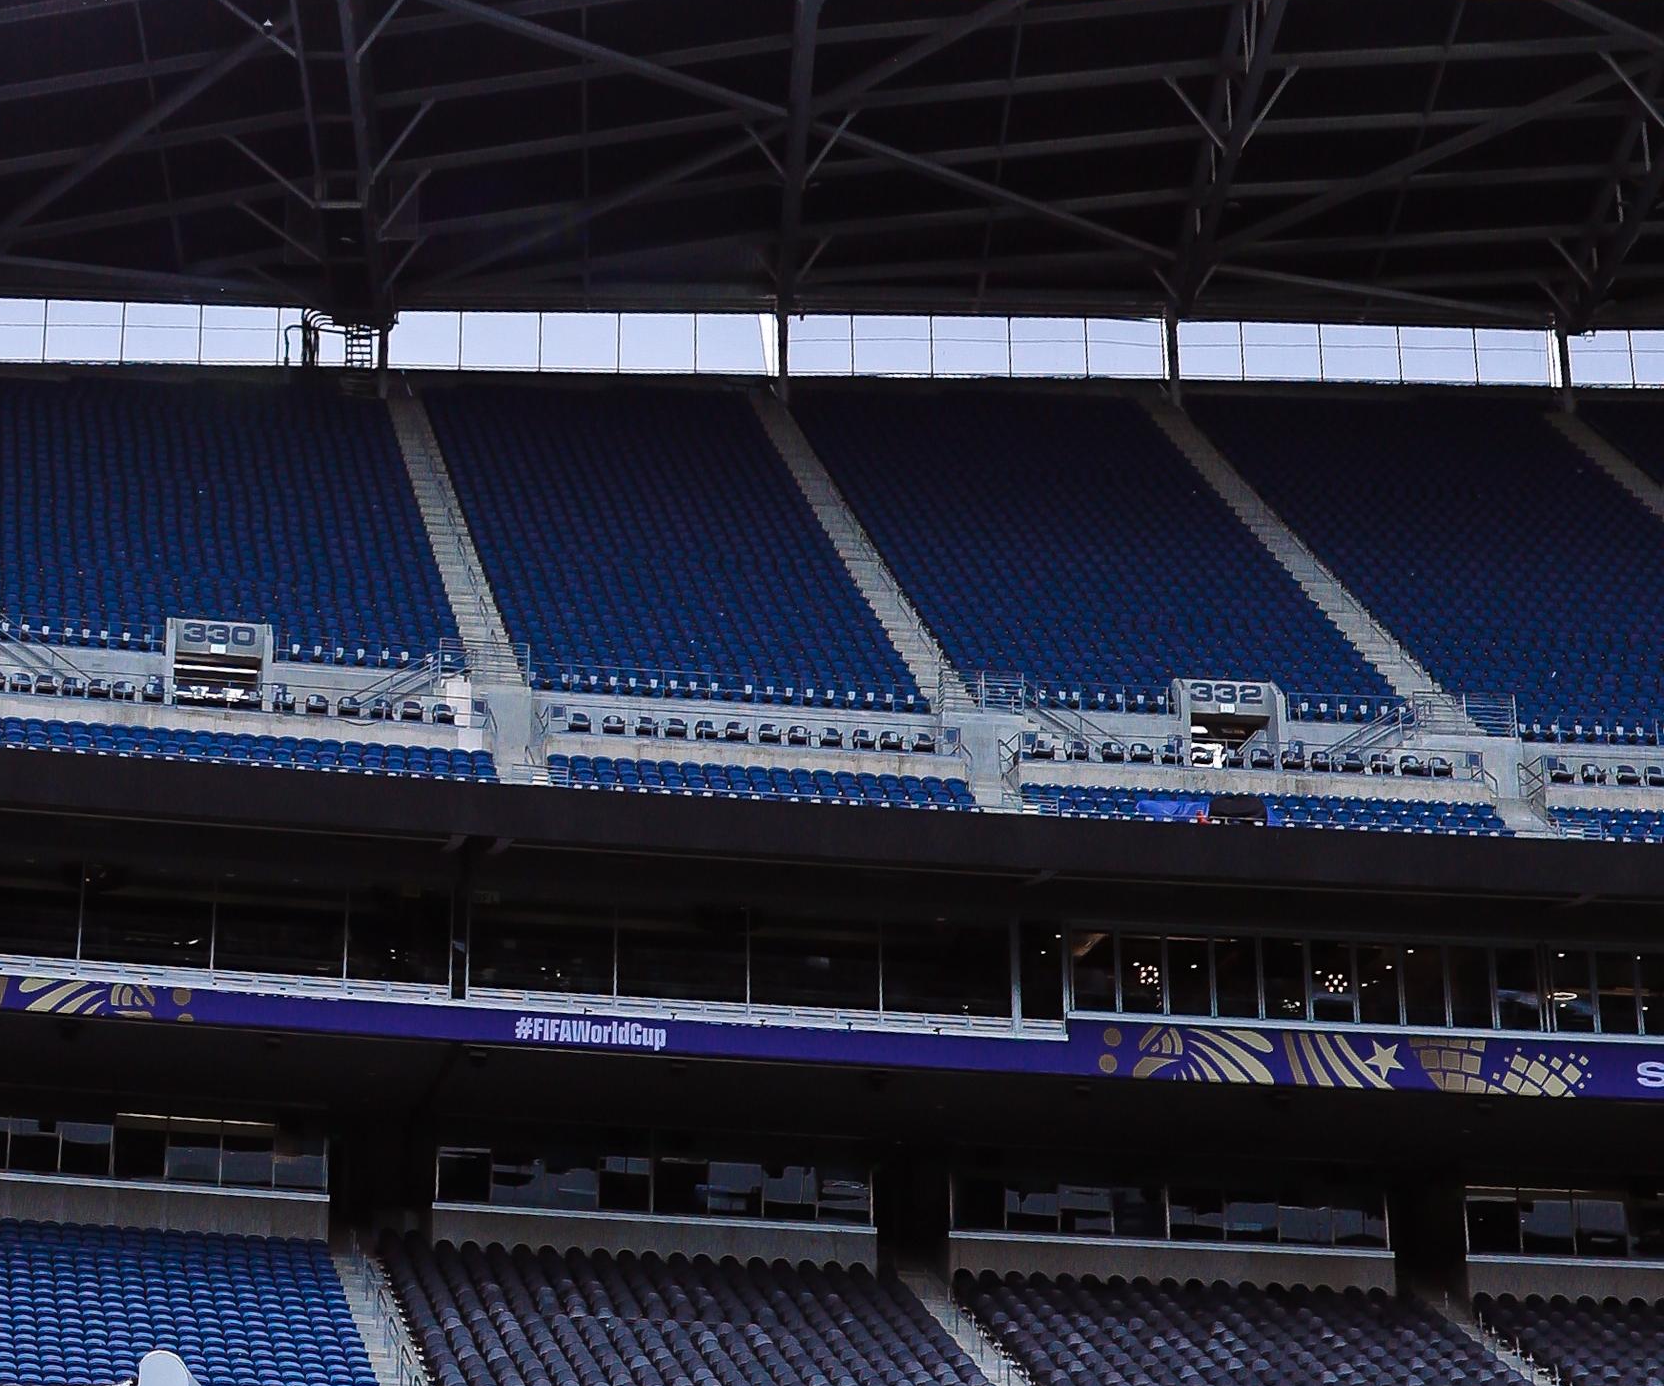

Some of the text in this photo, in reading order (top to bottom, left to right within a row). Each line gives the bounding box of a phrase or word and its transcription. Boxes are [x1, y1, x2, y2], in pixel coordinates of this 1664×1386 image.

[184, 623, 255, 646] 330
[1191, 682, 1263, 704] 332
[515, 1017, 667, 1051] #FIFAWorldCup
